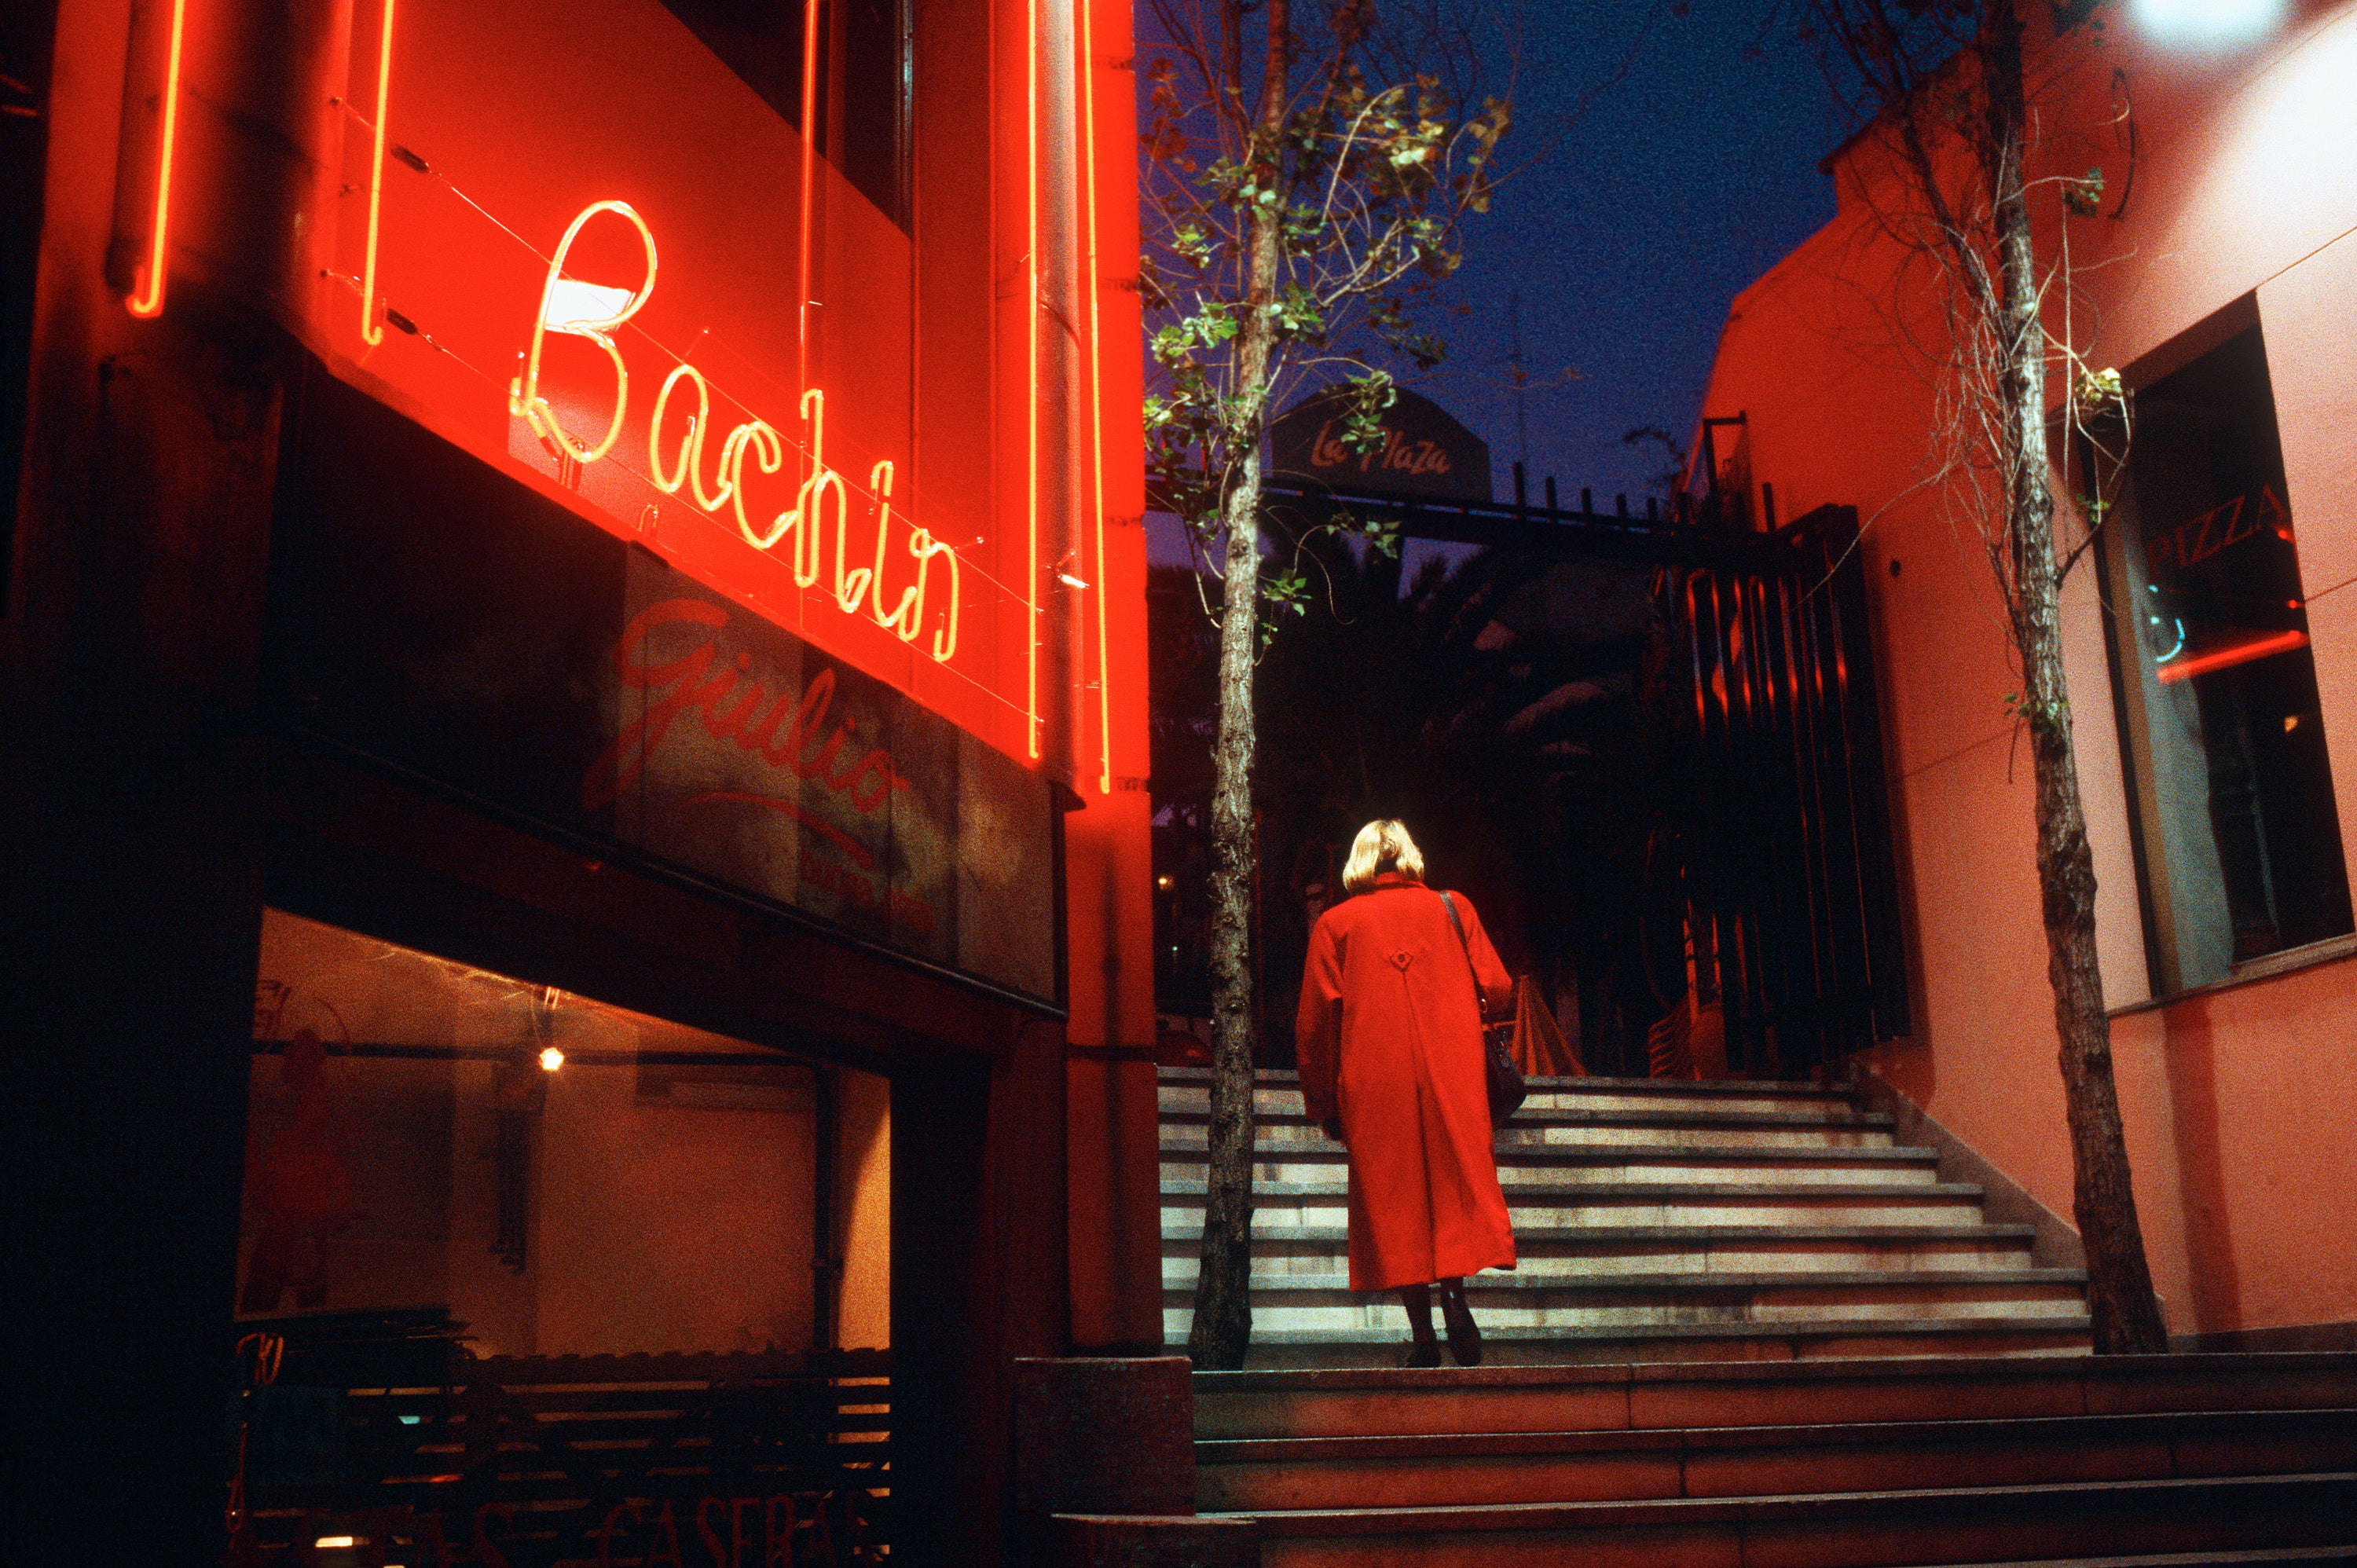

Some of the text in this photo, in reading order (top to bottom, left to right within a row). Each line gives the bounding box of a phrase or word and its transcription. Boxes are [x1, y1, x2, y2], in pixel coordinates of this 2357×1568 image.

[1310, 419, 1349, 468] La
[2147, 484, 2287, 583] PIZZA
[581, 598, 910, 815] Giulio
